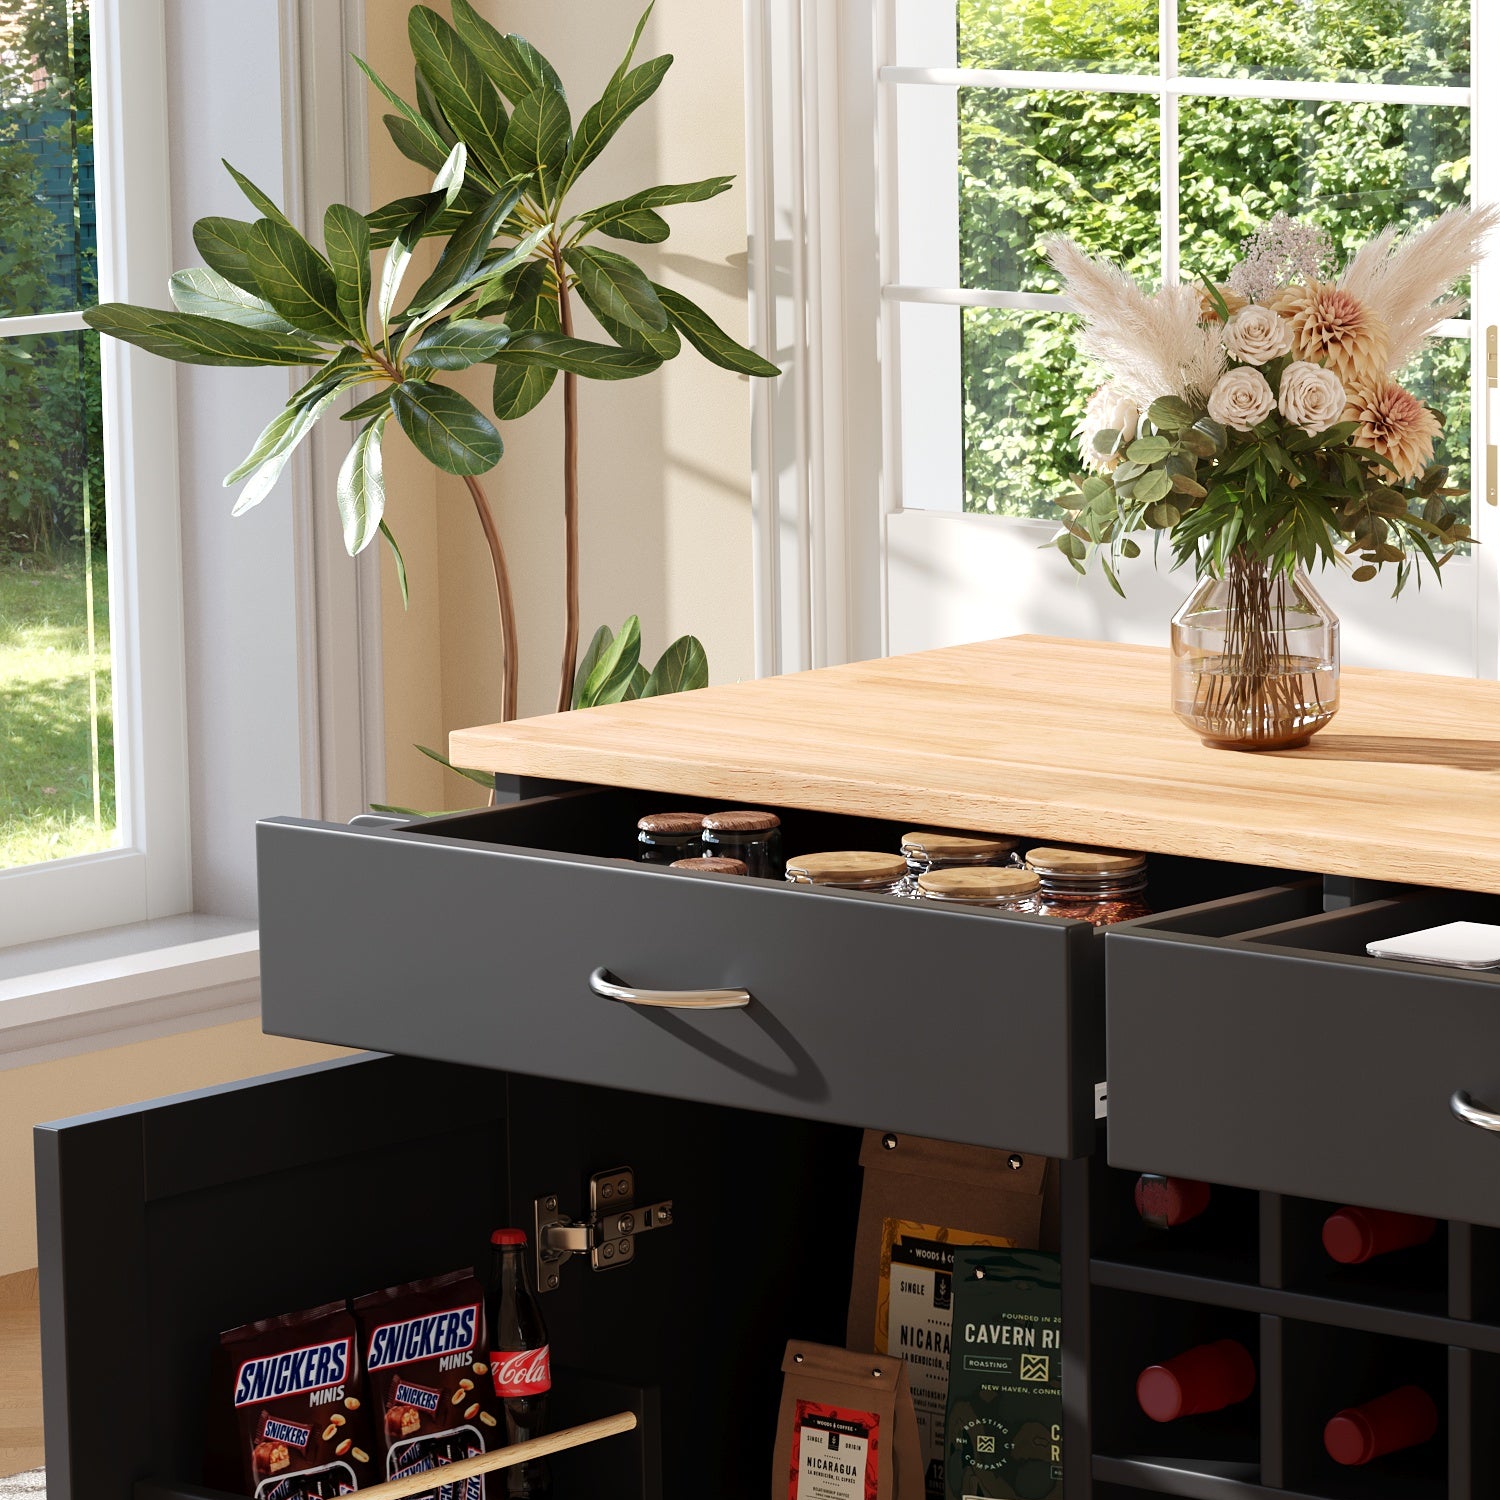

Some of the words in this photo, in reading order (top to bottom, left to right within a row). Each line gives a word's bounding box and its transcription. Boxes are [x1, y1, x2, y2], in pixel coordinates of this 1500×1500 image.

[915, 1247, 940, 1262] WOODS
[900, 1281, 925, 1295] SINGLE
[1001, 1313, 1039, 1322] FOUNDED
[369, 1308, 475, 1369] SNICKERS
[900, 1325, 950, 1354] NICARA
[964, 1323, 1036, 1348] CAVERN
[439, 1351, 474, 1373] MINIS
[968, 1360, 1008, 1369] ROASTING
[236, 1342, 347, 1405] SNICKERS
[310, 1385, 345, 1408] MINIS
[397, 1385, 439, 1410] SNICKERS
[265, 1421, 309, 1446] SNICKERS
[963, 1418, 1009, 1435] ROASTING
[807, 1435, 823, 1444] SINGLE
[807, 1456, 857, 1477] NICARAGUA
[964, 1454, 1008, 1470] COMPANY
